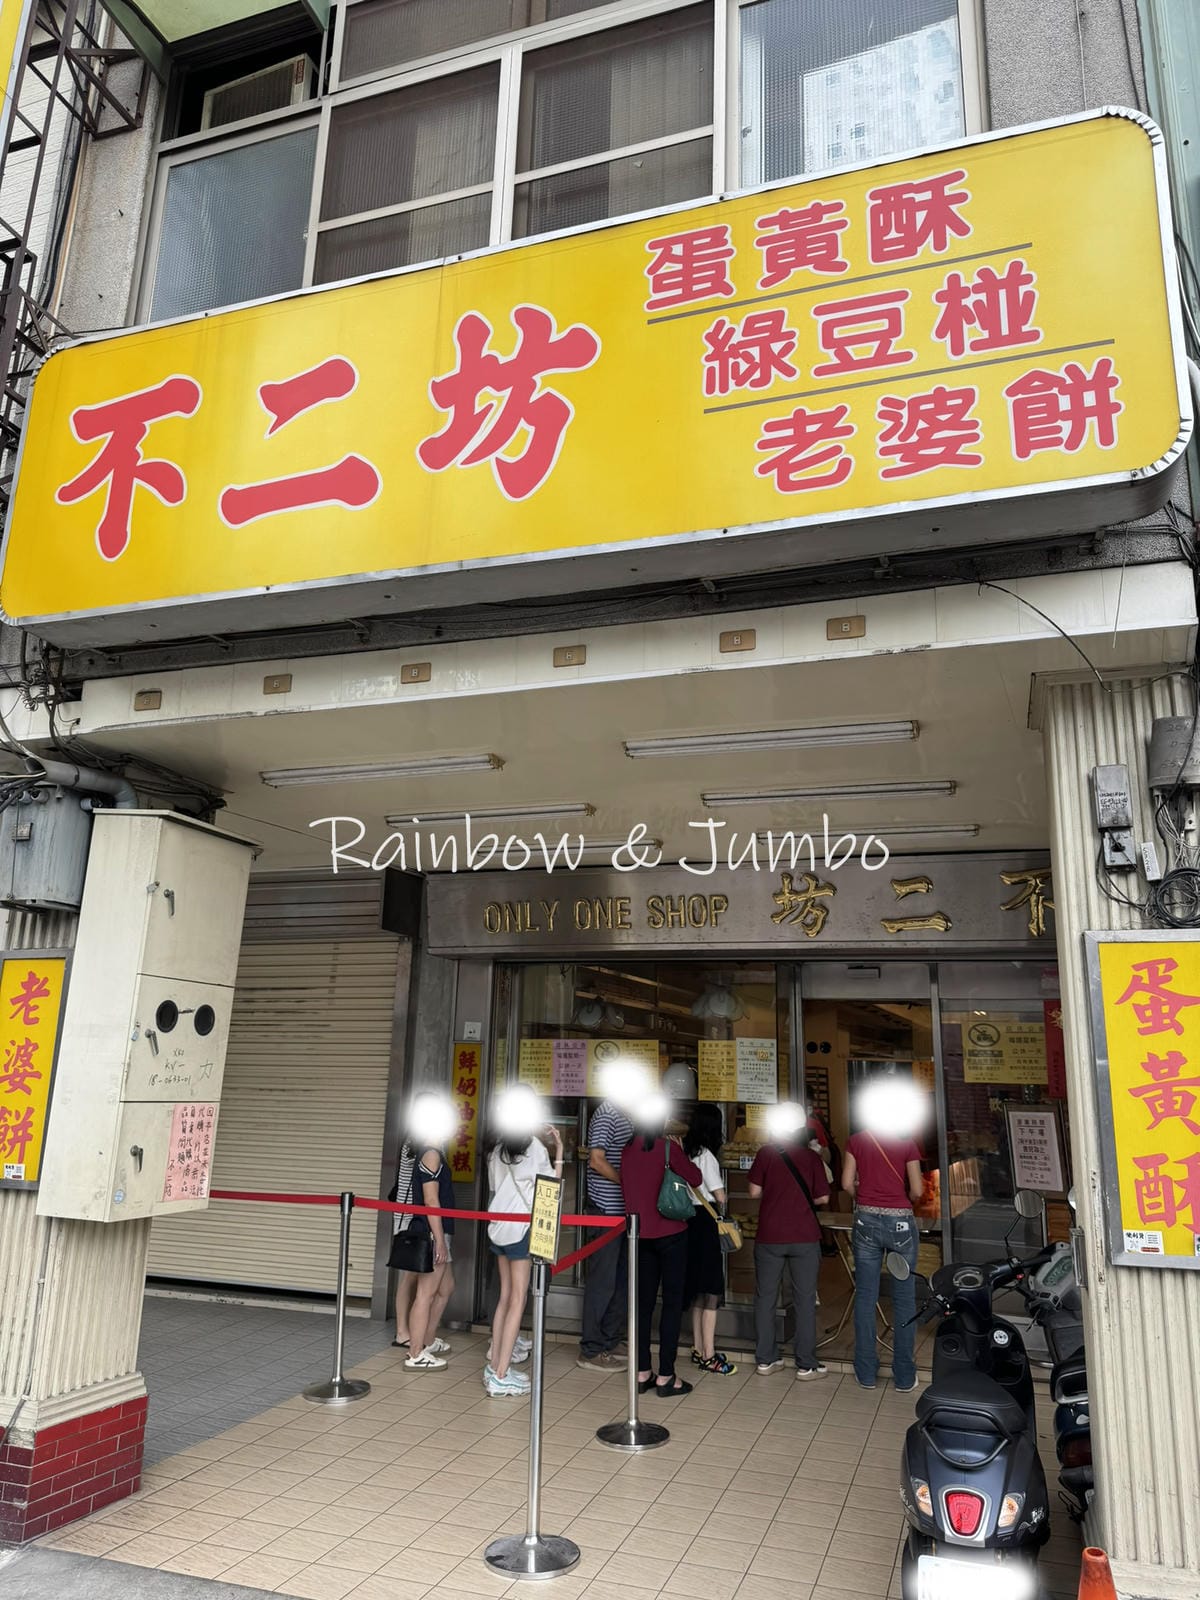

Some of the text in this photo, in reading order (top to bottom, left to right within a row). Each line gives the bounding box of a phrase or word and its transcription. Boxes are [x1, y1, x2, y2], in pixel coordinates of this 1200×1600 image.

[643, 168, 974, 312] 蛋黃酥
[701, 258, 1043, 398] 綠豆椪
[55, 303, 602, 562] 不二坊
[754, 355, 1126, 495] 老婆餅
[484, 893, 729, 935] ONLY ONE SHOP
[0, 970, 50, 1165] 老婆餅
[452, 1050, 478, 1173] 鮮奶油蛋糕
